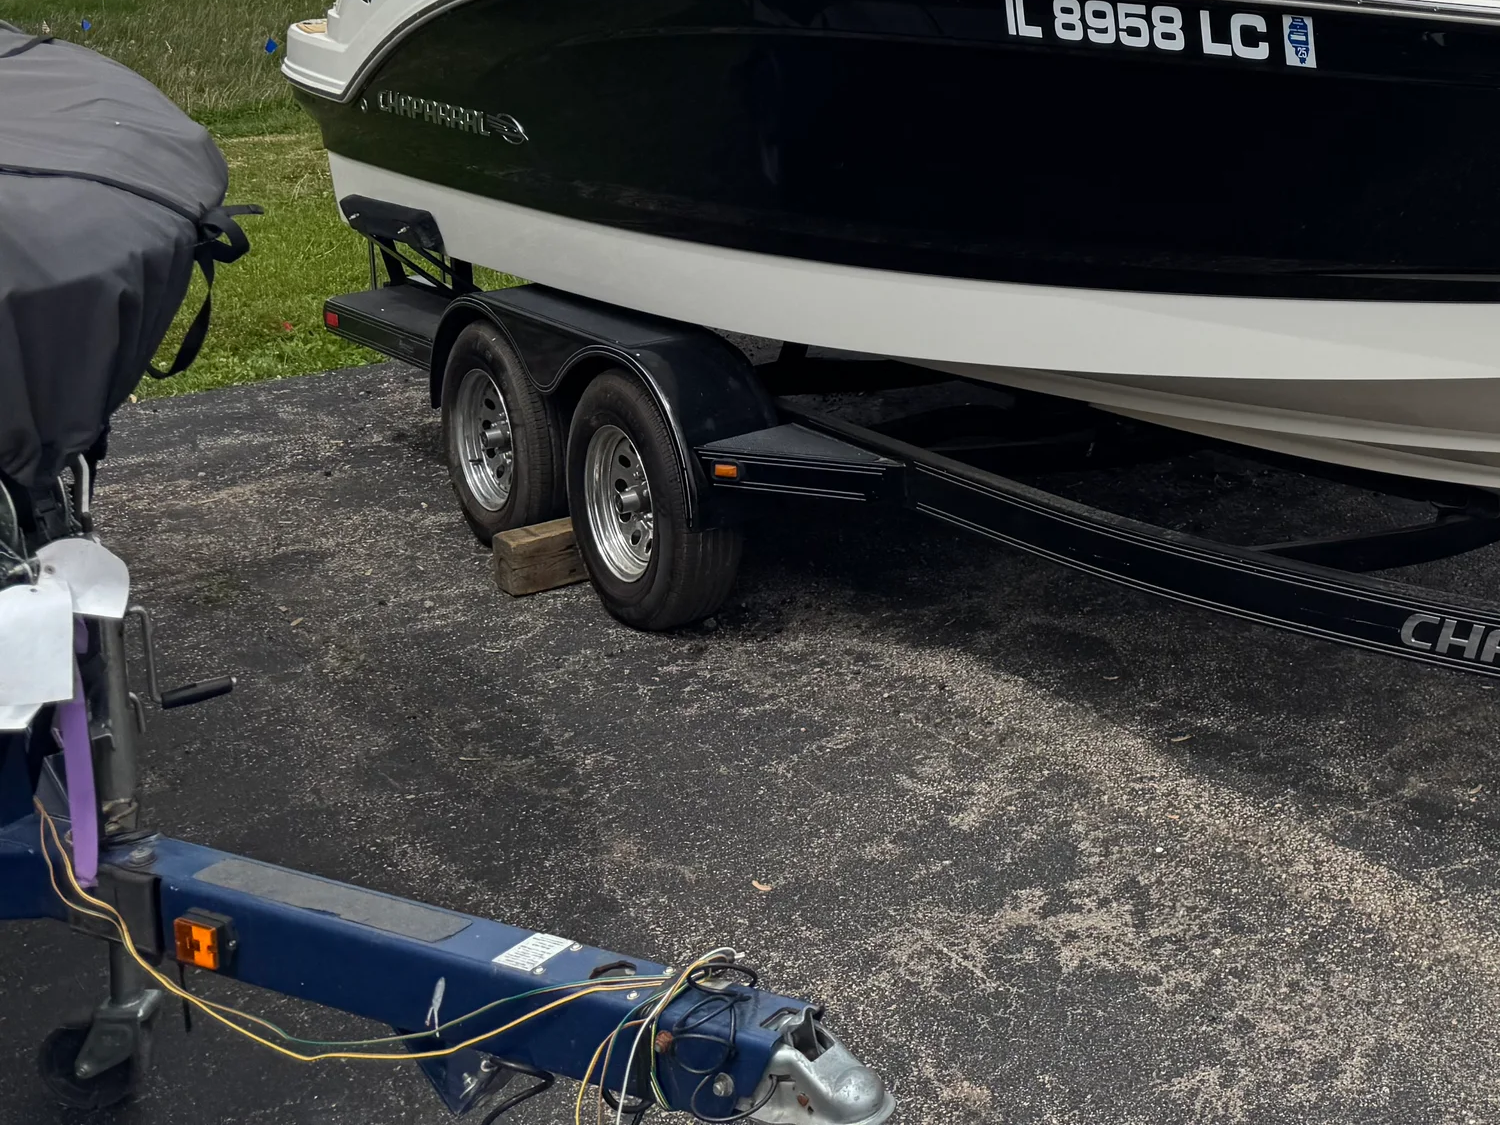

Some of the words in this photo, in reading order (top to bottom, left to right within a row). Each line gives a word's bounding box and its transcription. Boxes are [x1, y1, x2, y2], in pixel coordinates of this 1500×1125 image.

[1199, 10, 1269, 60] LC
[1298, 47, 1307, 58] 25
[378, 90, 491, 136] CHAPARRAL
